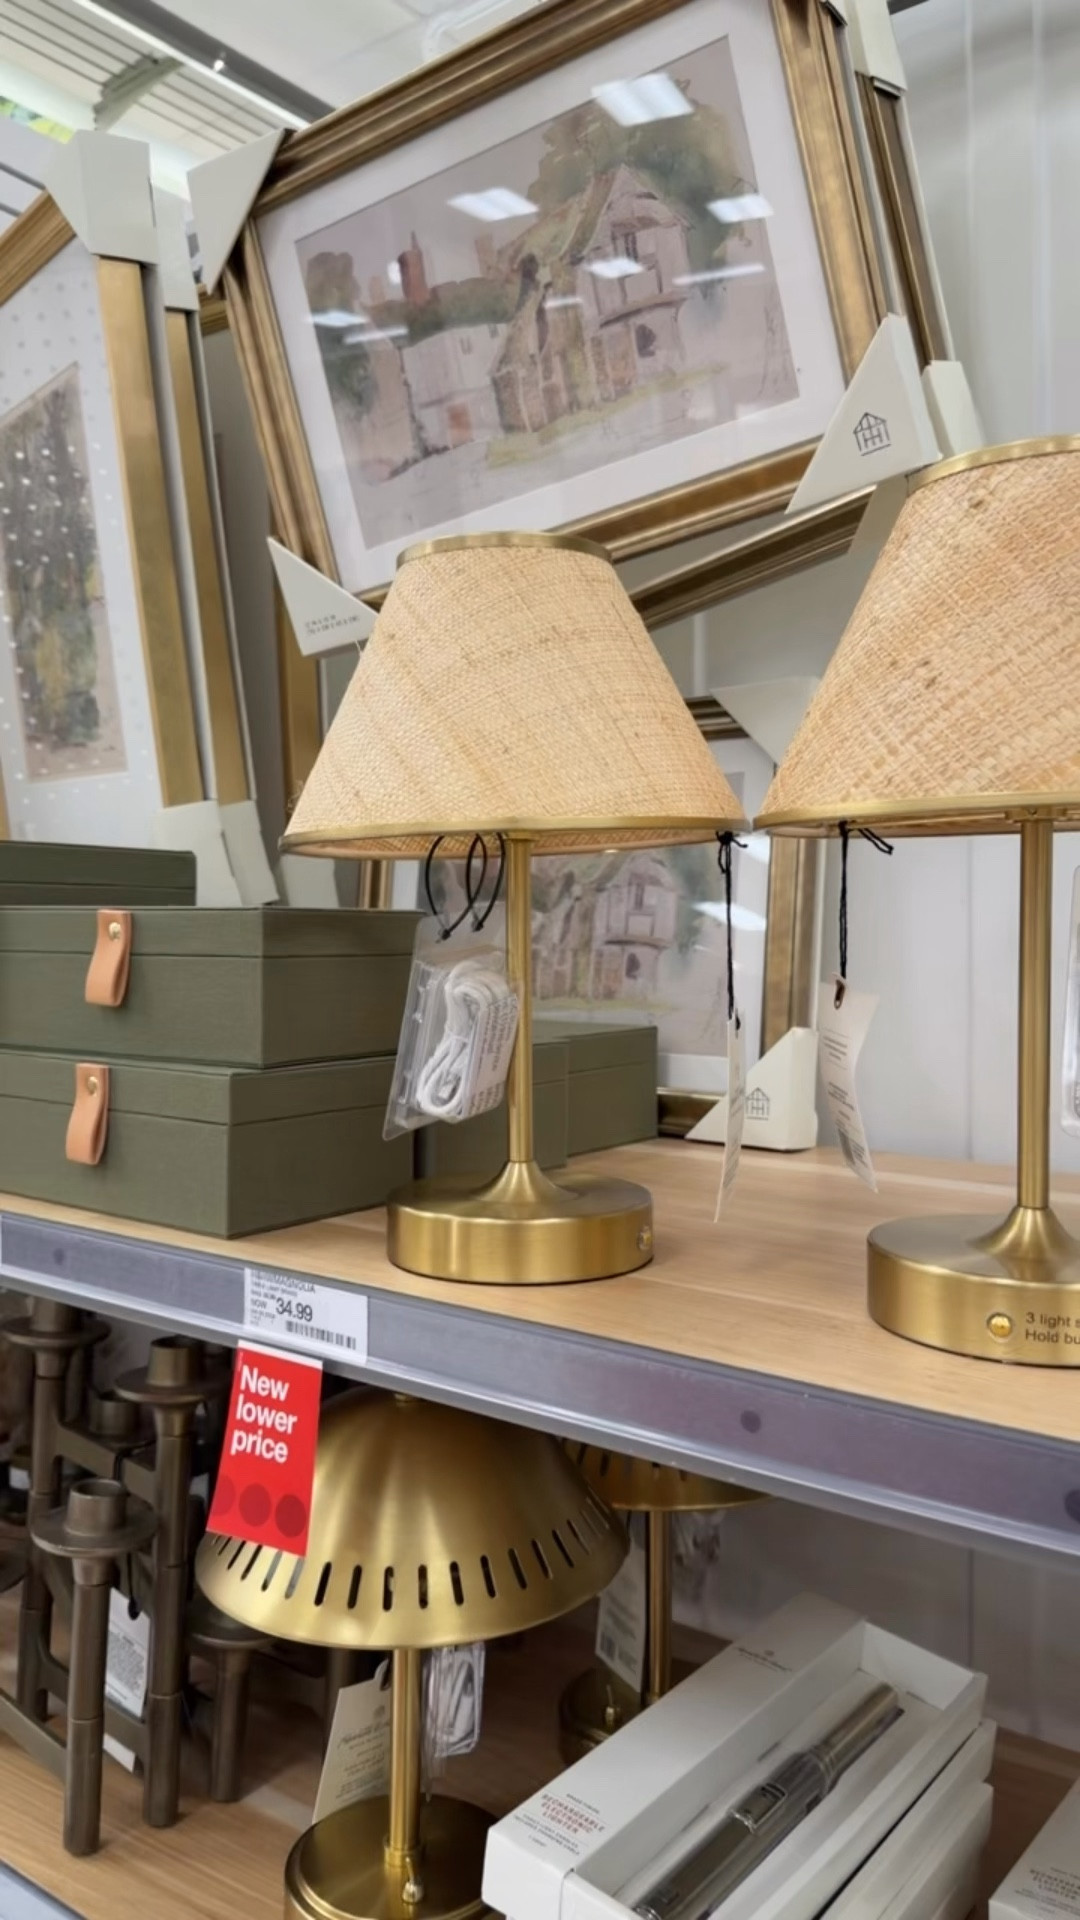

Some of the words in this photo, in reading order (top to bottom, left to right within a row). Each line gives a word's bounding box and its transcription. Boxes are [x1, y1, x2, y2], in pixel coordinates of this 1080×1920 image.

[276, 1296, 313, 1323] 34.99
[1025, 1311, 1036, 1325] 3
[1040, 1313, 1071, 1330] light
[1025, 1329, 1060, 1344] Hold
[239, 1364, 290, 1402] New
[235, 1393, 298, 1435] lower
[229, 1429, 289, 1464] price
